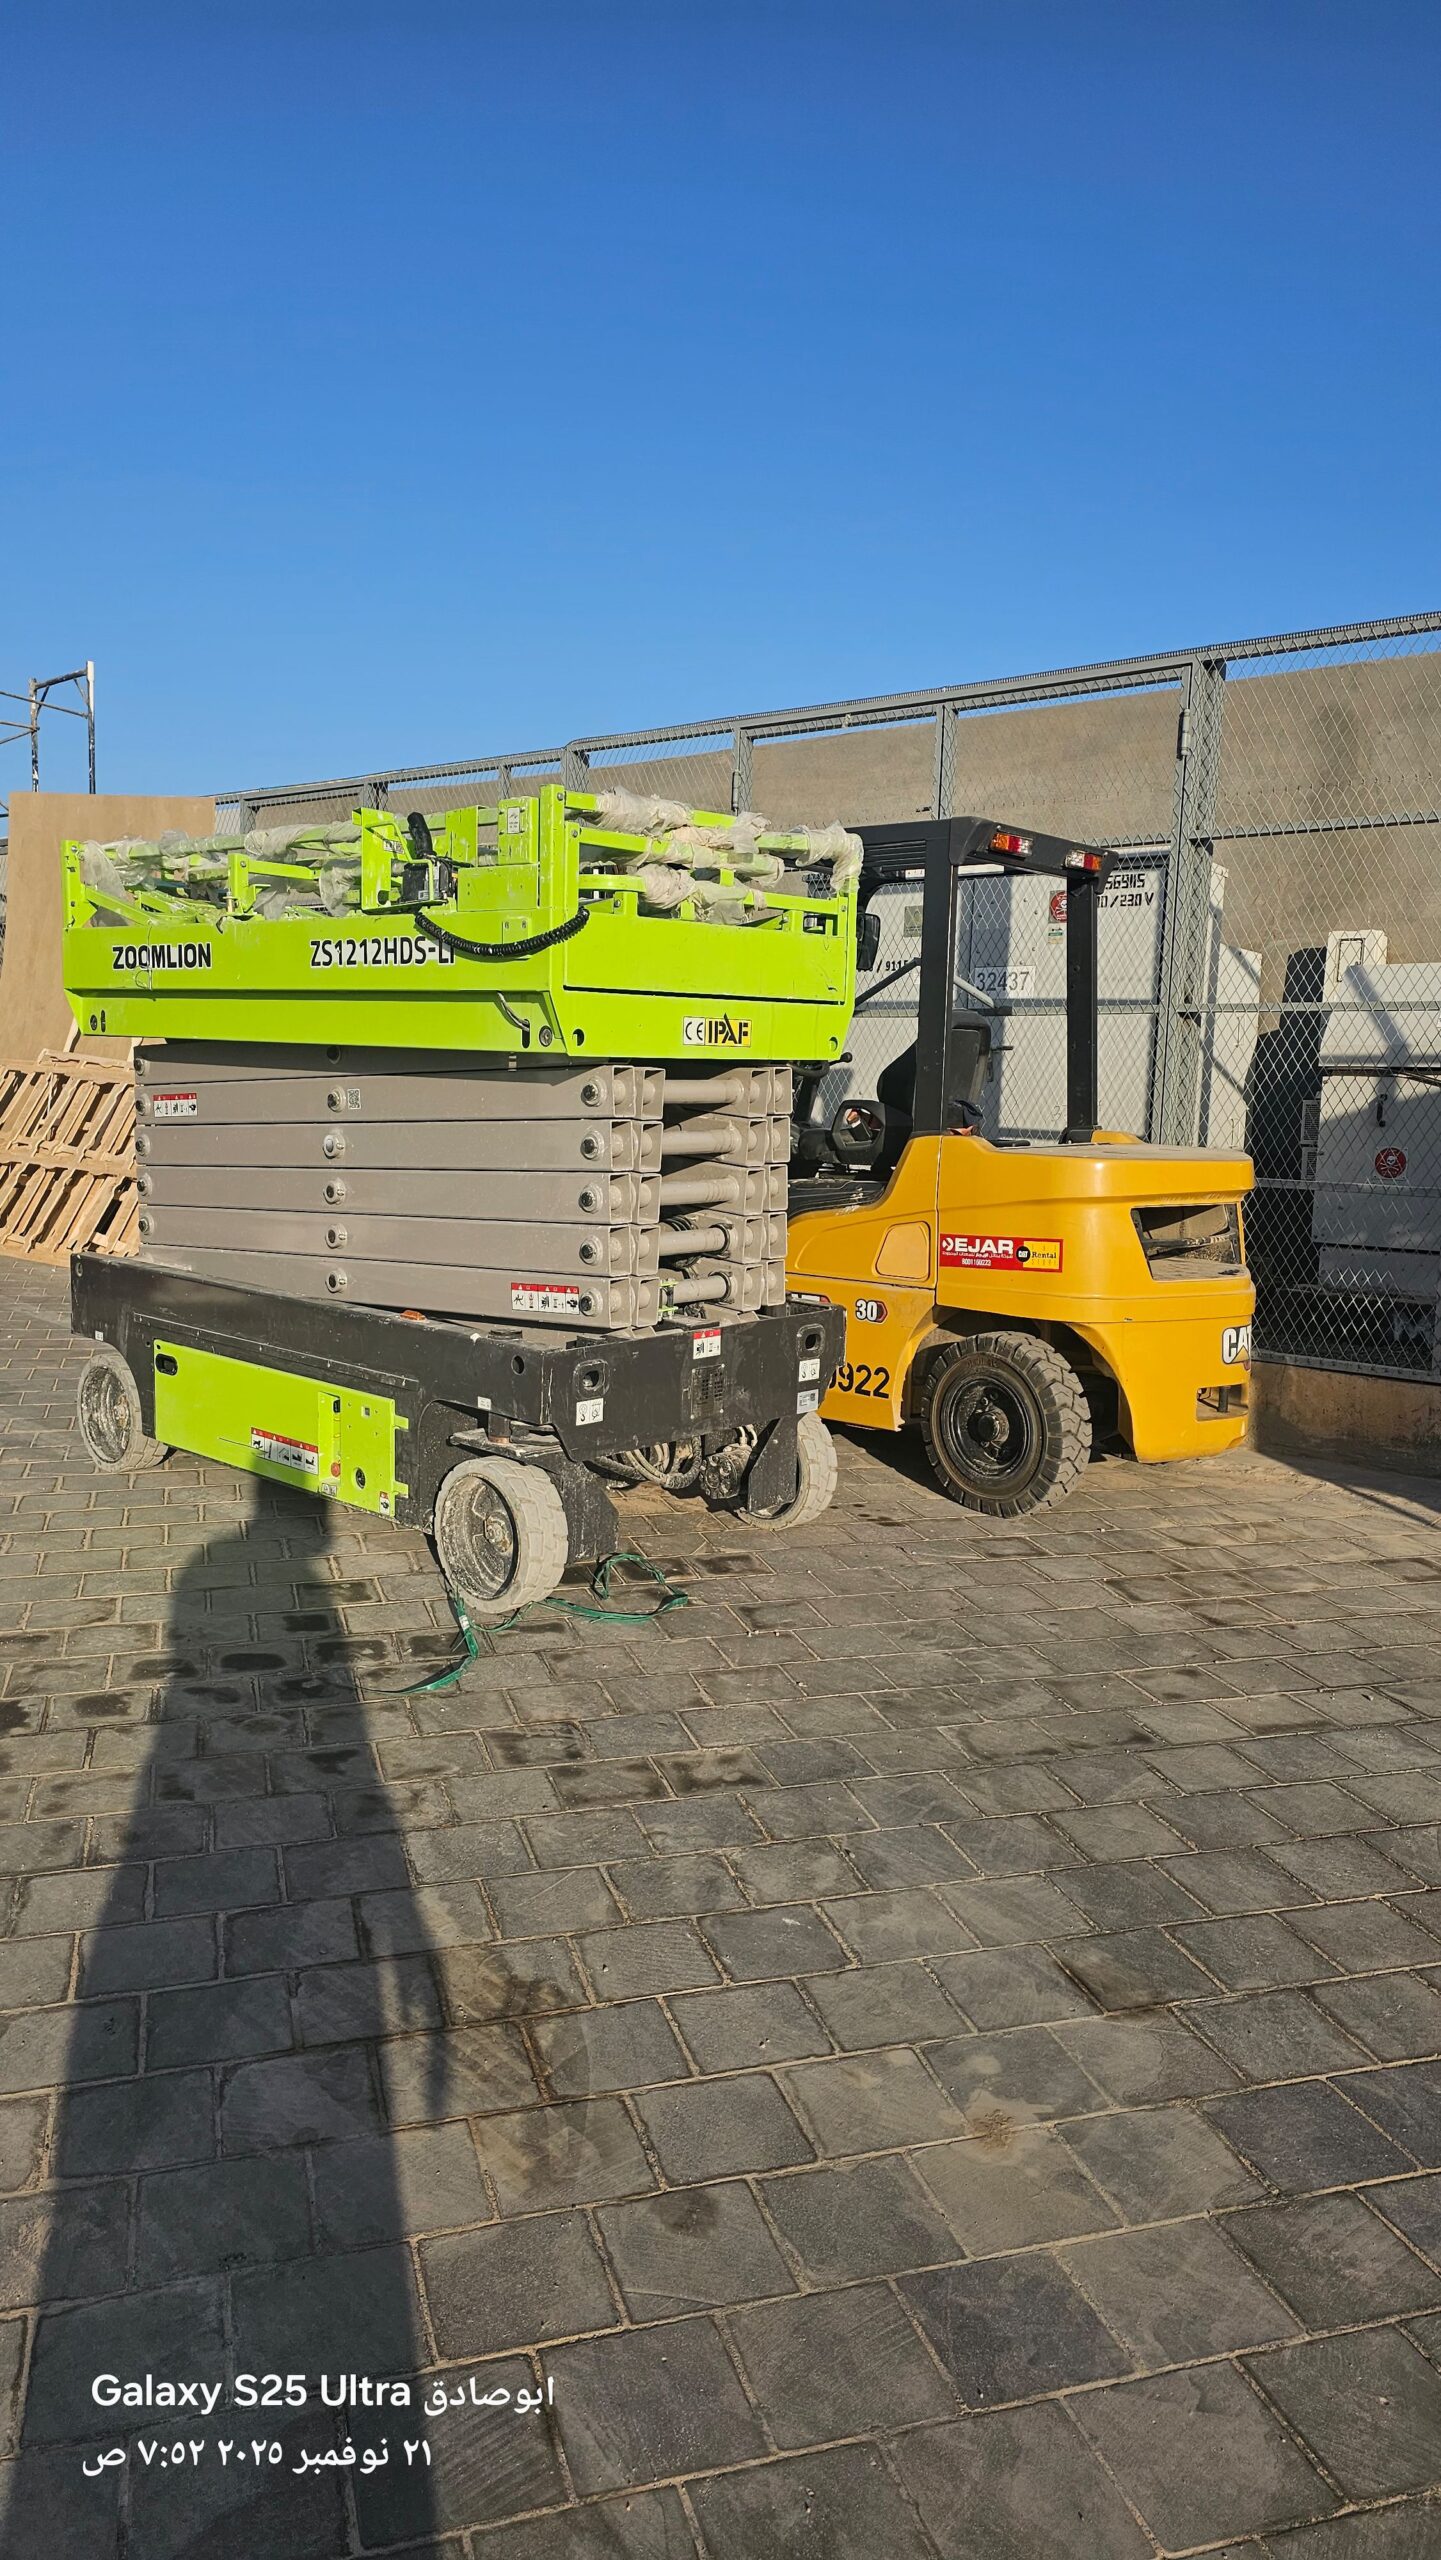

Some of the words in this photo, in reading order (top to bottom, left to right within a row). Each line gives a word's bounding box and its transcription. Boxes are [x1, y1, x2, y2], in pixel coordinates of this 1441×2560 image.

[112, 943, 211, 969] ZOOMLION
[976, 971, 1030, 992] 32437
[685, 1021, 704, 1041] CE
[708, 1012, 749, 1044] IPAF
[1031, 1251, 1057, 1259] Rental
[856, 1299, 878, 1321] 30
